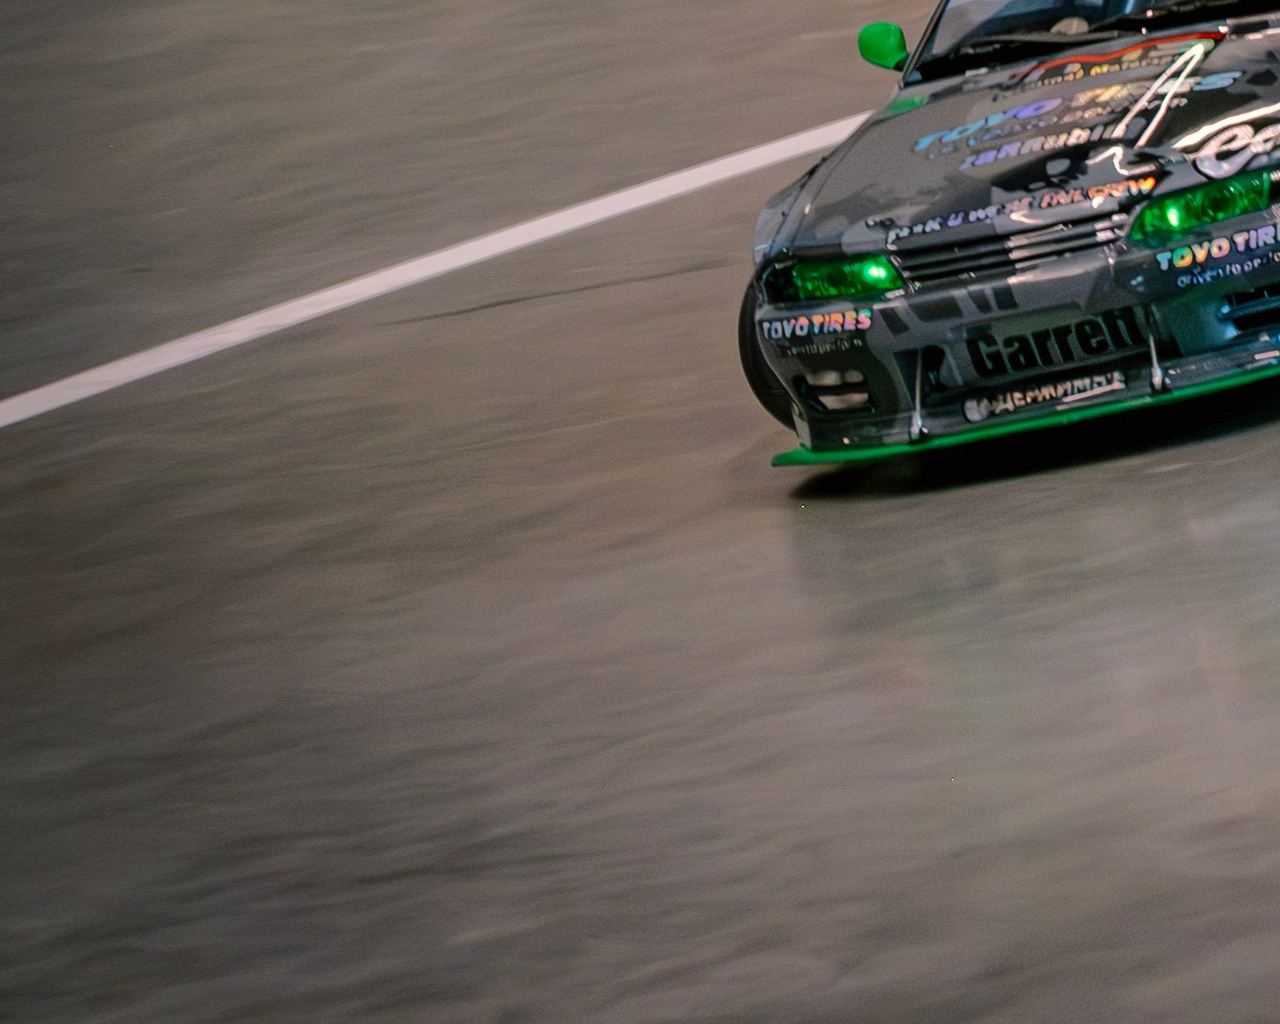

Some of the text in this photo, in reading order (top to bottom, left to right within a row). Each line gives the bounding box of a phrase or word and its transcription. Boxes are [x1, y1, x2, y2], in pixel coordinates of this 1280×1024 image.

[1155, 233, 1230, 271] TOYO
[762, 309, 872, 341] TOYO TIRES
[970, 304, 1149, 376] Garrett
